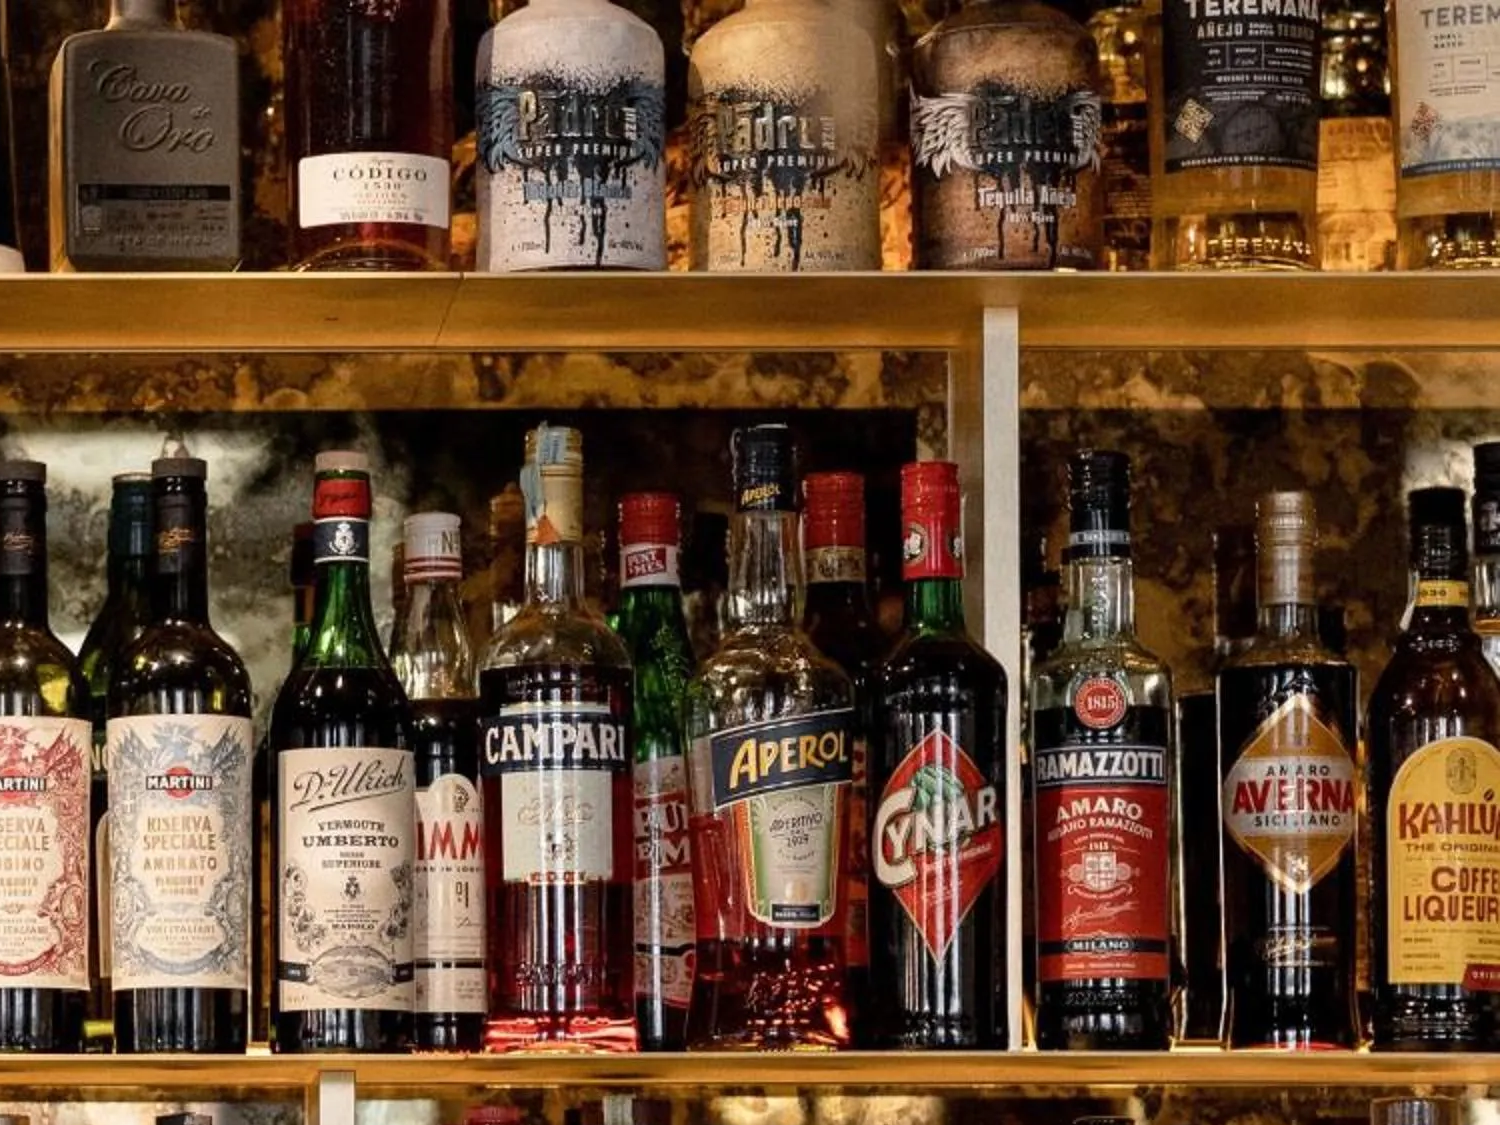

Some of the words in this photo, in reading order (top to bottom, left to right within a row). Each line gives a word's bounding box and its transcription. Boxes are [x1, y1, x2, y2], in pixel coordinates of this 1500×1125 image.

[1197, 22, 1244, 39] AÑEJO
[119, 103, 215, 153] Oro
[1024, 150, 1078, 164] PREMIU
[332, 163, 428, 182] CÓDIGO
[978, 187, 1034, 209] Tequila
[485, 721, 626, 765] CAMPARI
[729, 731, 848, 790] APEROL
[1037, 749, 1165, 781] RAMAZZOTTI
[1265, 764, 1331, 777] AMARO
[146, 775, 211, 791] MARTINI
[1232, 778, 1355, 815] AVERNA
[1055, 796, 1143, 824] AMARO
[1399, 789, 1500, 840] KAHLÚ
[147, 815, 213, 834] RISERVA
[317, 819, 385, 833] VERMOUTH
[1254, 813, 1342, 828] SICIIANO
[143, 834, 218, 851] SPECIALE
[301, 834, 400, 848] UMBERTO
[872, 785, 997, 888] CYNAR
[1406, 843, 1435, 853] THE
[143, 855, 219, 872] AMBRATO
[321, 859, 382, 869] SUPERIORE
[1403, 895, 1499, 922] LIQUEUR
[1072, 940, 1130, 951] MILANO
